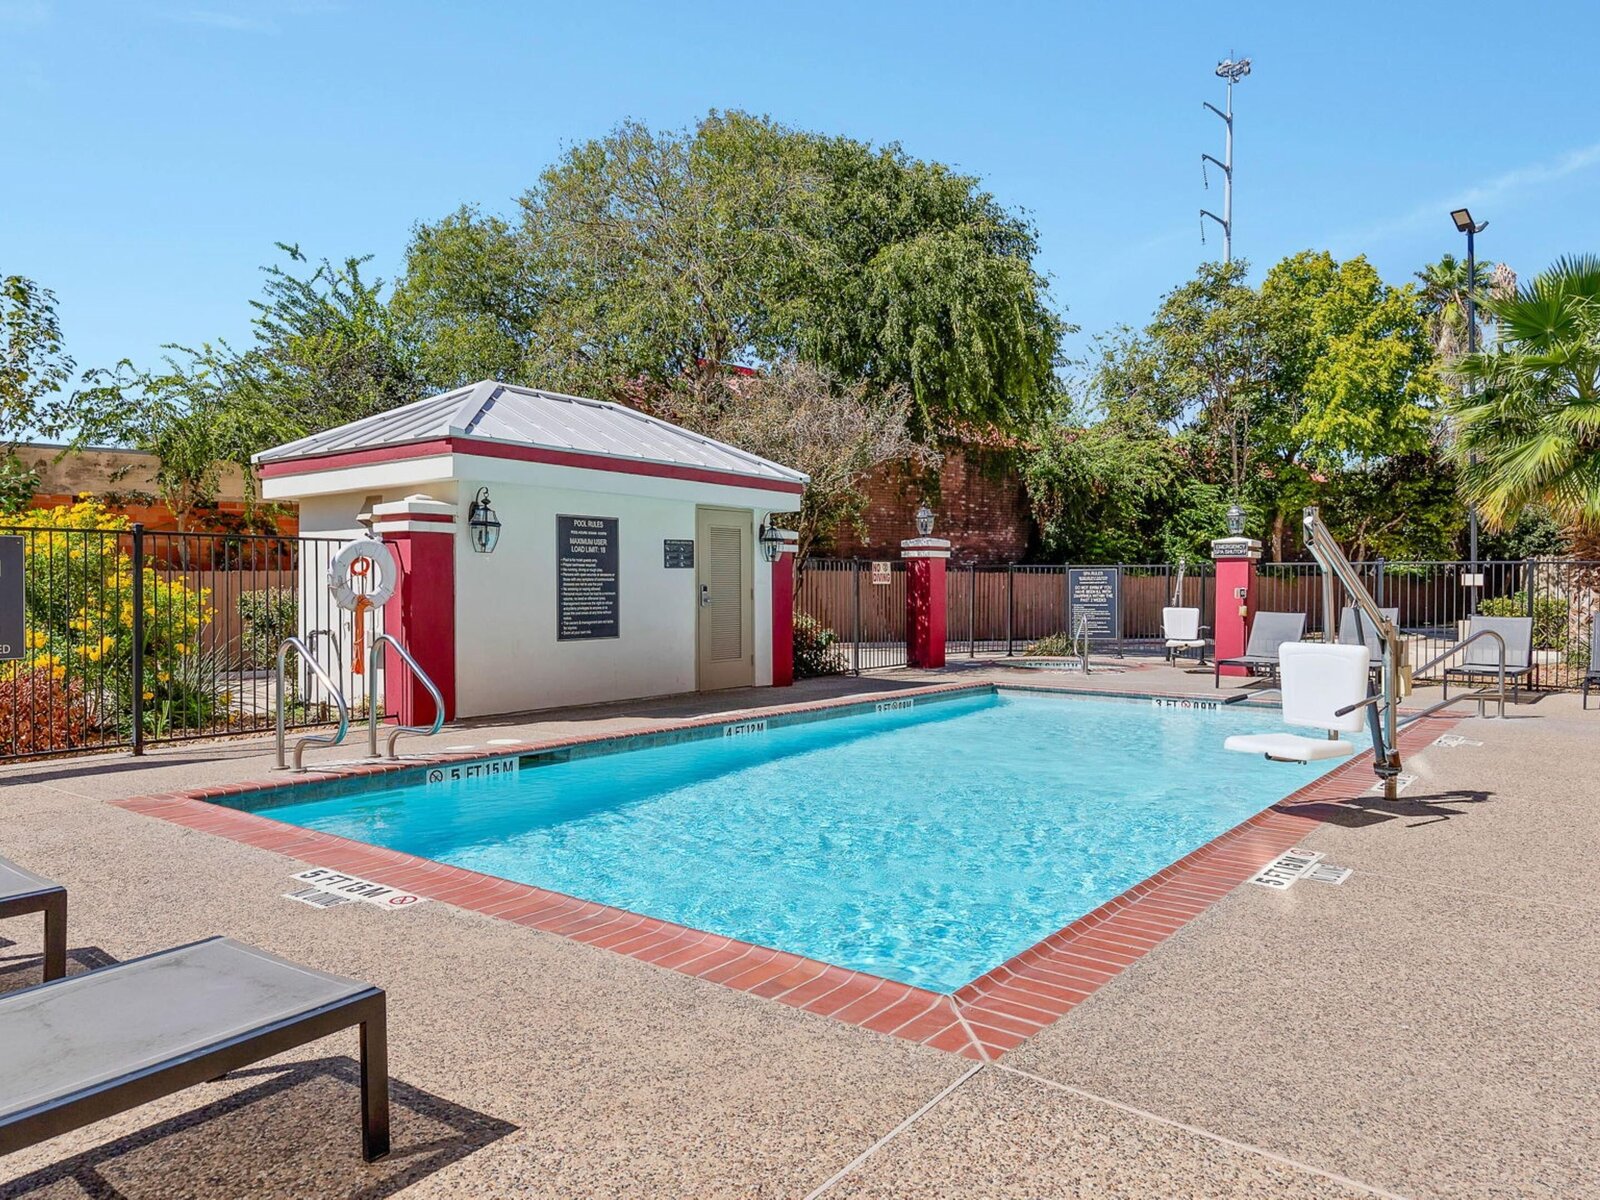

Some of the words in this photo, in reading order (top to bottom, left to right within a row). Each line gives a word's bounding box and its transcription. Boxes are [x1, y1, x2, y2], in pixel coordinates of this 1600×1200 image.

[736, 725, 744, 735] FT
[451, 769, 460, 780] 5
[467, 765, 481, 778] FT
[300, 869, 328, 879] 5
[315, 874, 353, 890] FT
[1264, 869, 1296, 880] FT
[1255, 877, 1284, 886] 5
